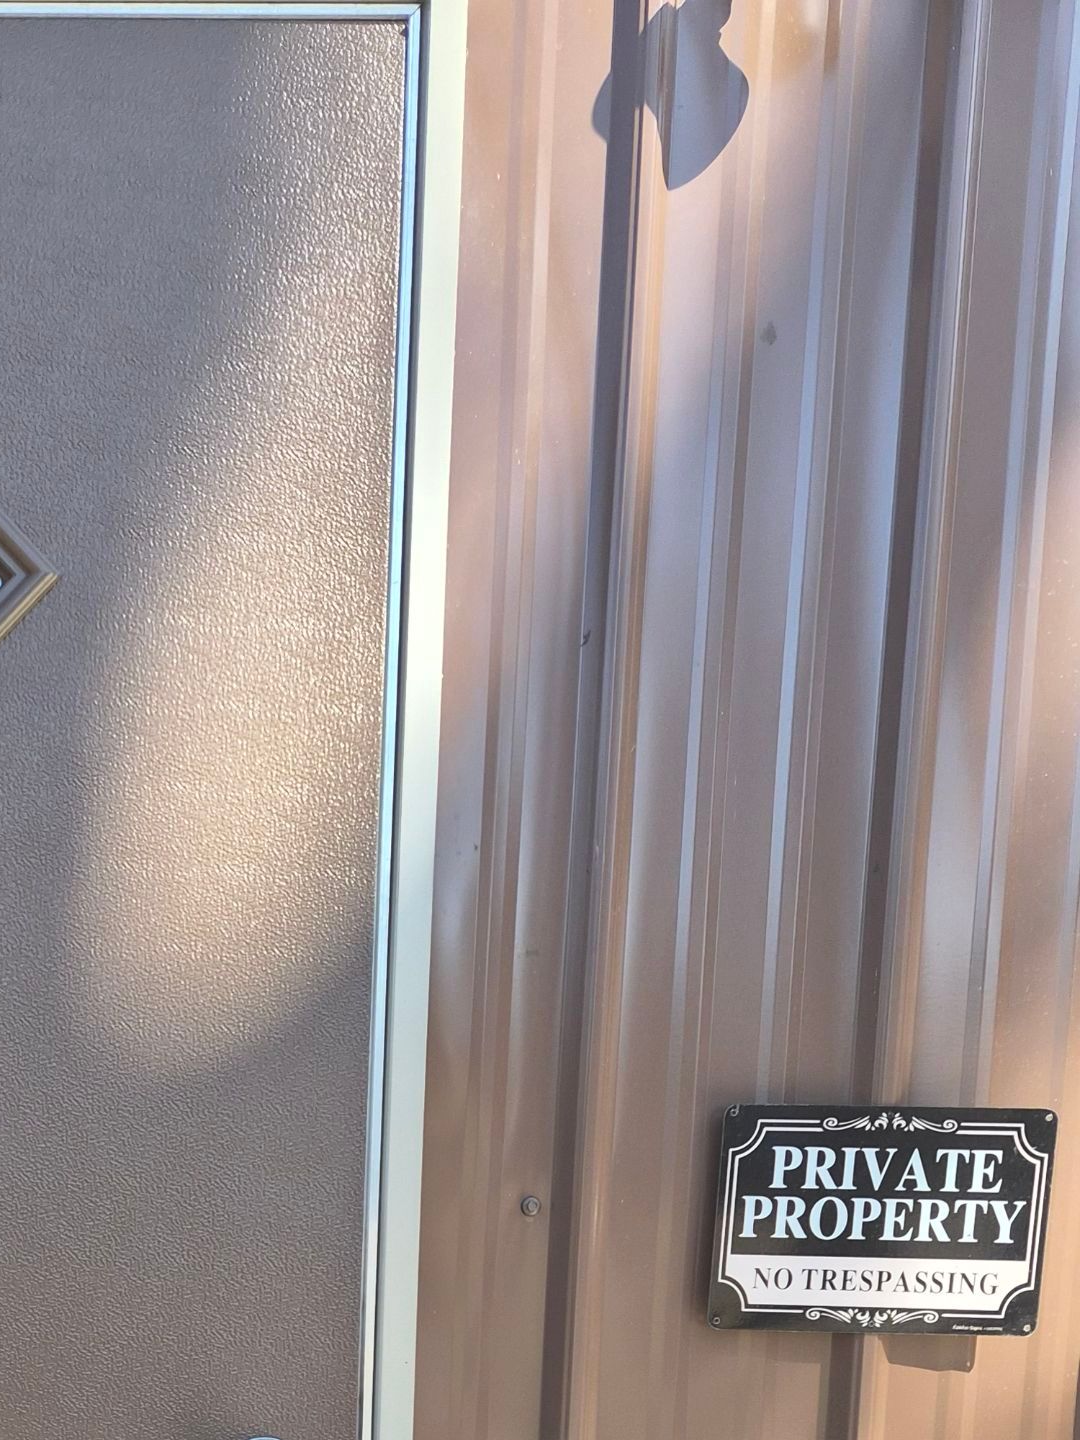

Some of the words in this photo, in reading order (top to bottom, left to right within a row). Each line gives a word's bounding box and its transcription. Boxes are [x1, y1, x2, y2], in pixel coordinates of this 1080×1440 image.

[768, 1146, 1004, 1194] PRIVATE
[738, 1195, 1027, 1244] PROPERTY
[752, 1267, 793, 1290] NO
[801, 1268, 999, 1296] TRESPASSING
